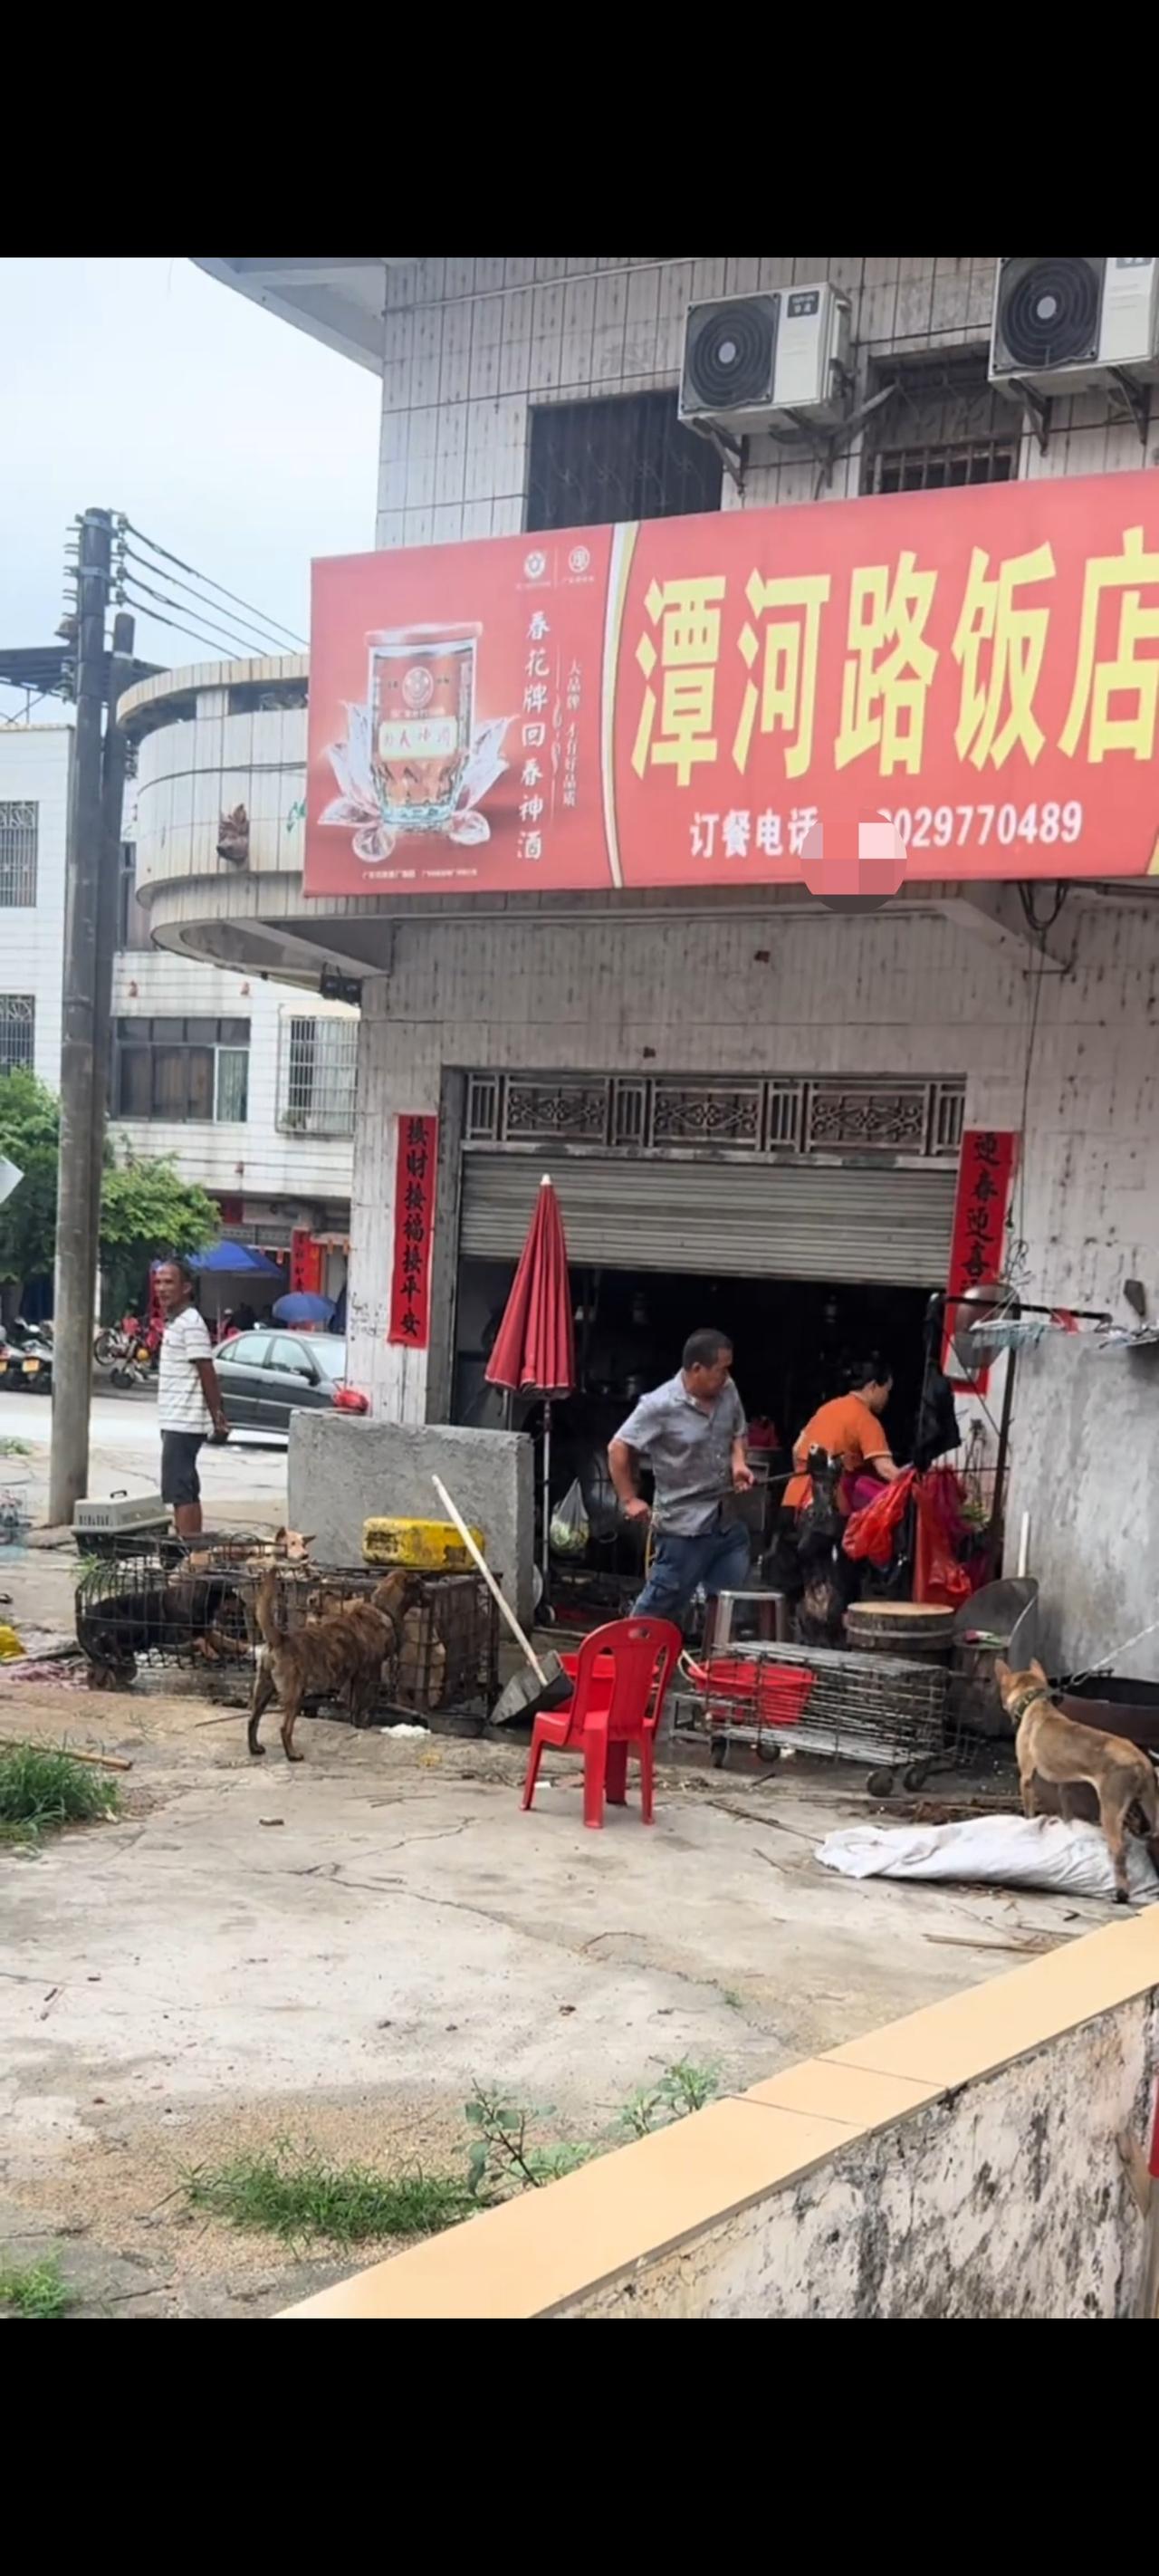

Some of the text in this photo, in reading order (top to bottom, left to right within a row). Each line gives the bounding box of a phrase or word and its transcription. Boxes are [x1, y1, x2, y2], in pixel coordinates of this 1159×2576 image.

[517, 610, 551, 860] 春花牌回春神酒
[631, 525, 1159, 786] 潭河路饭店
[876, 801, 1083, 848] 029770489
